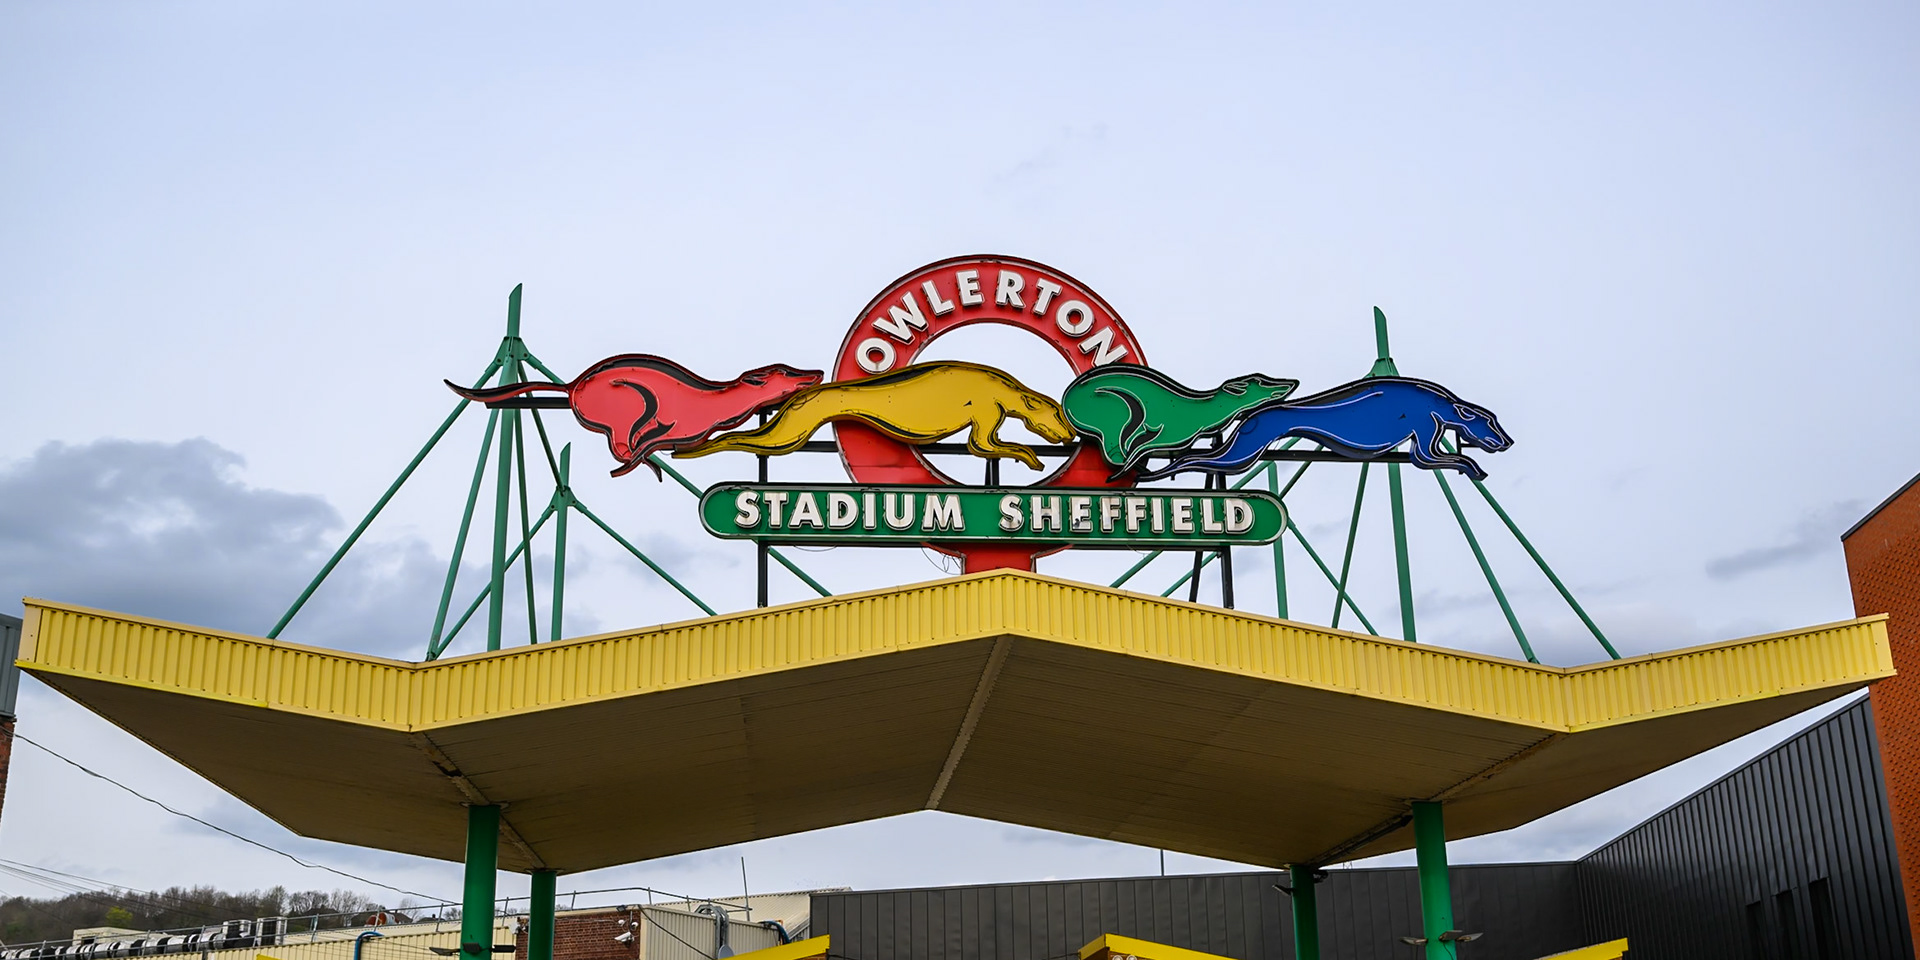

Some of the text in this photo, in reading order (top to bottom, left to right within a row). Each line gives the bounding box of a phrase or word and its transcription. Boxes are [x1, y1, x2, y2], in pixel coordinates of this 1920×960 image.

[855, 269, 1129, 374] OWLERTON
[733, 491, 1256, 534] STADIUM SHEFFIELD
